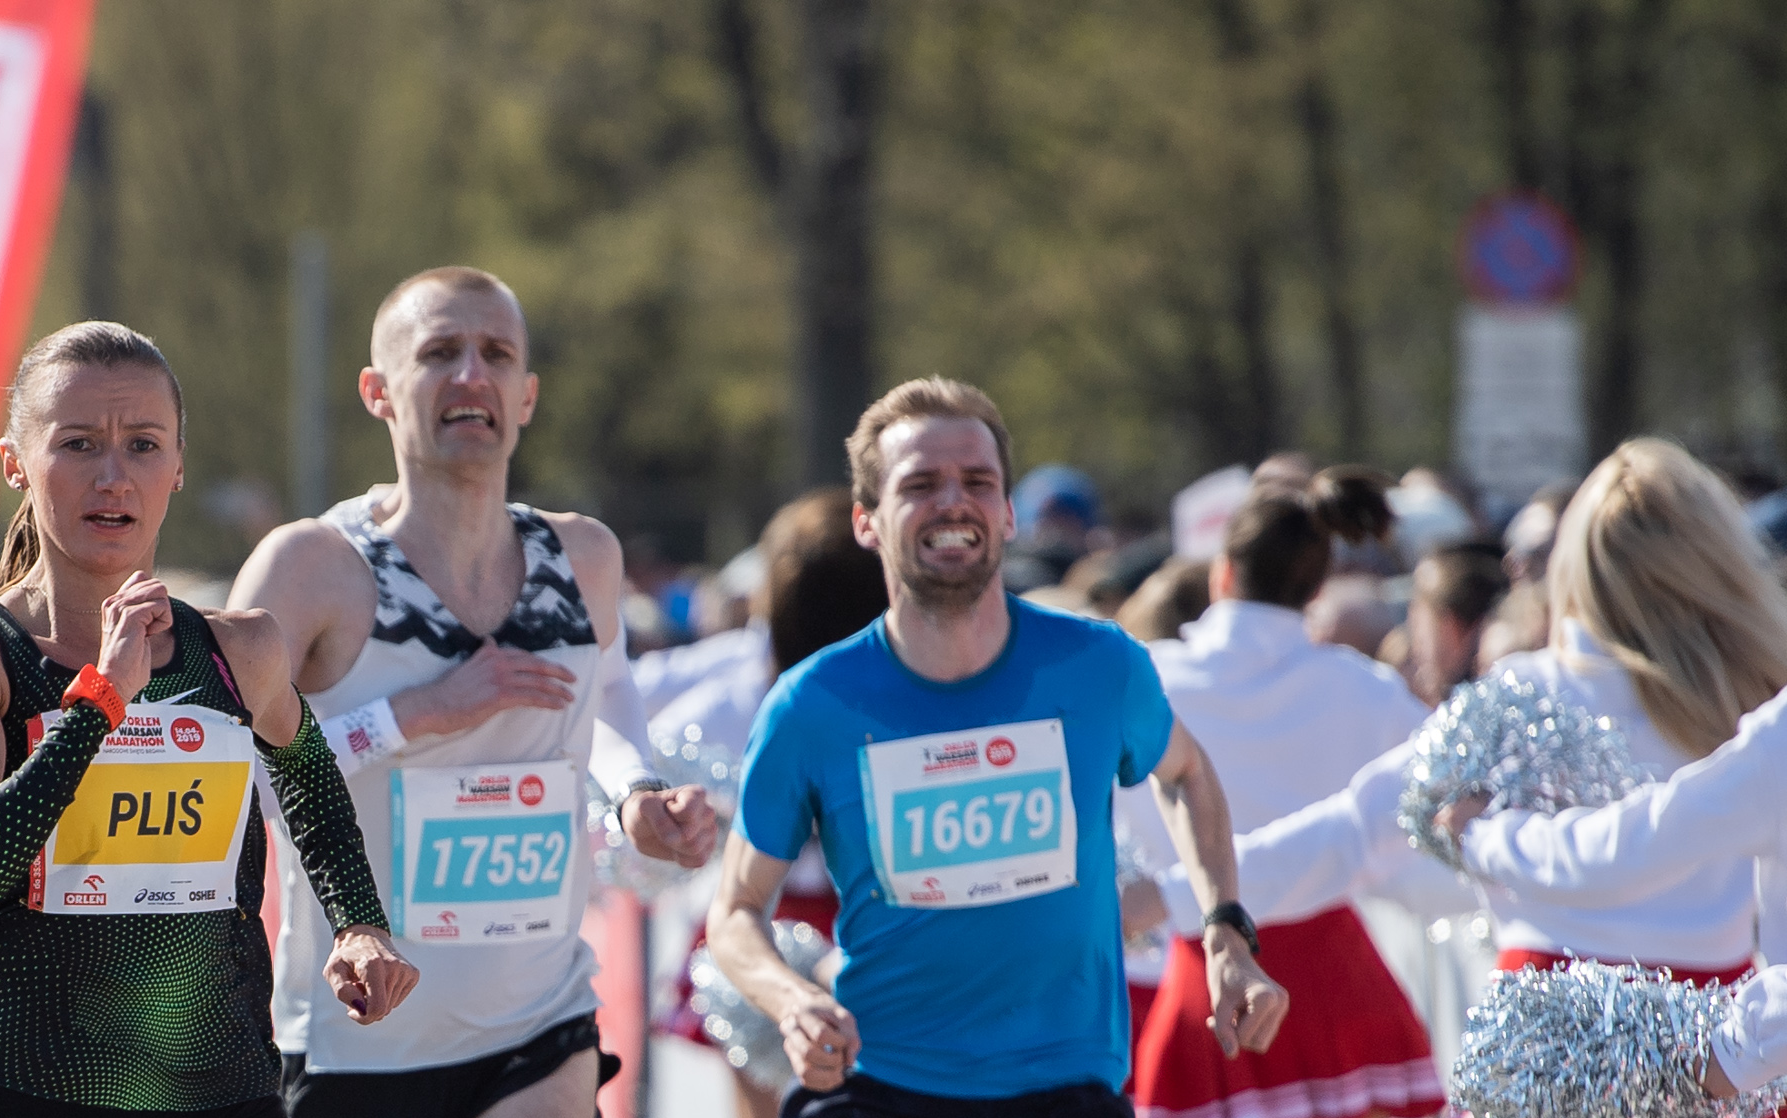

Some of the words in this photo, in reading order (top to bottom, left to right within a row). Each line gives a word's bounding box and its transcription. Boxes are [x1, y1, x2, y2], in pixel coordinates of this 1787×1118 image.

[127, 716, 161, 726] ORLEN
[118, 727, 163, 737] WARSAW
[105, 736, 165, 747] MARATHON
[176, 733, 201, 742] 2019
[107, 778, 205, 838] PLIŚ
[903, 787, 1055, 858] 16679
[431, 830, 566, 888] 17552
[65, 894, 105, 904] ORLEN
[147, 891, 176, 901] asics
[188, 889, 216, 902] OSHEE
